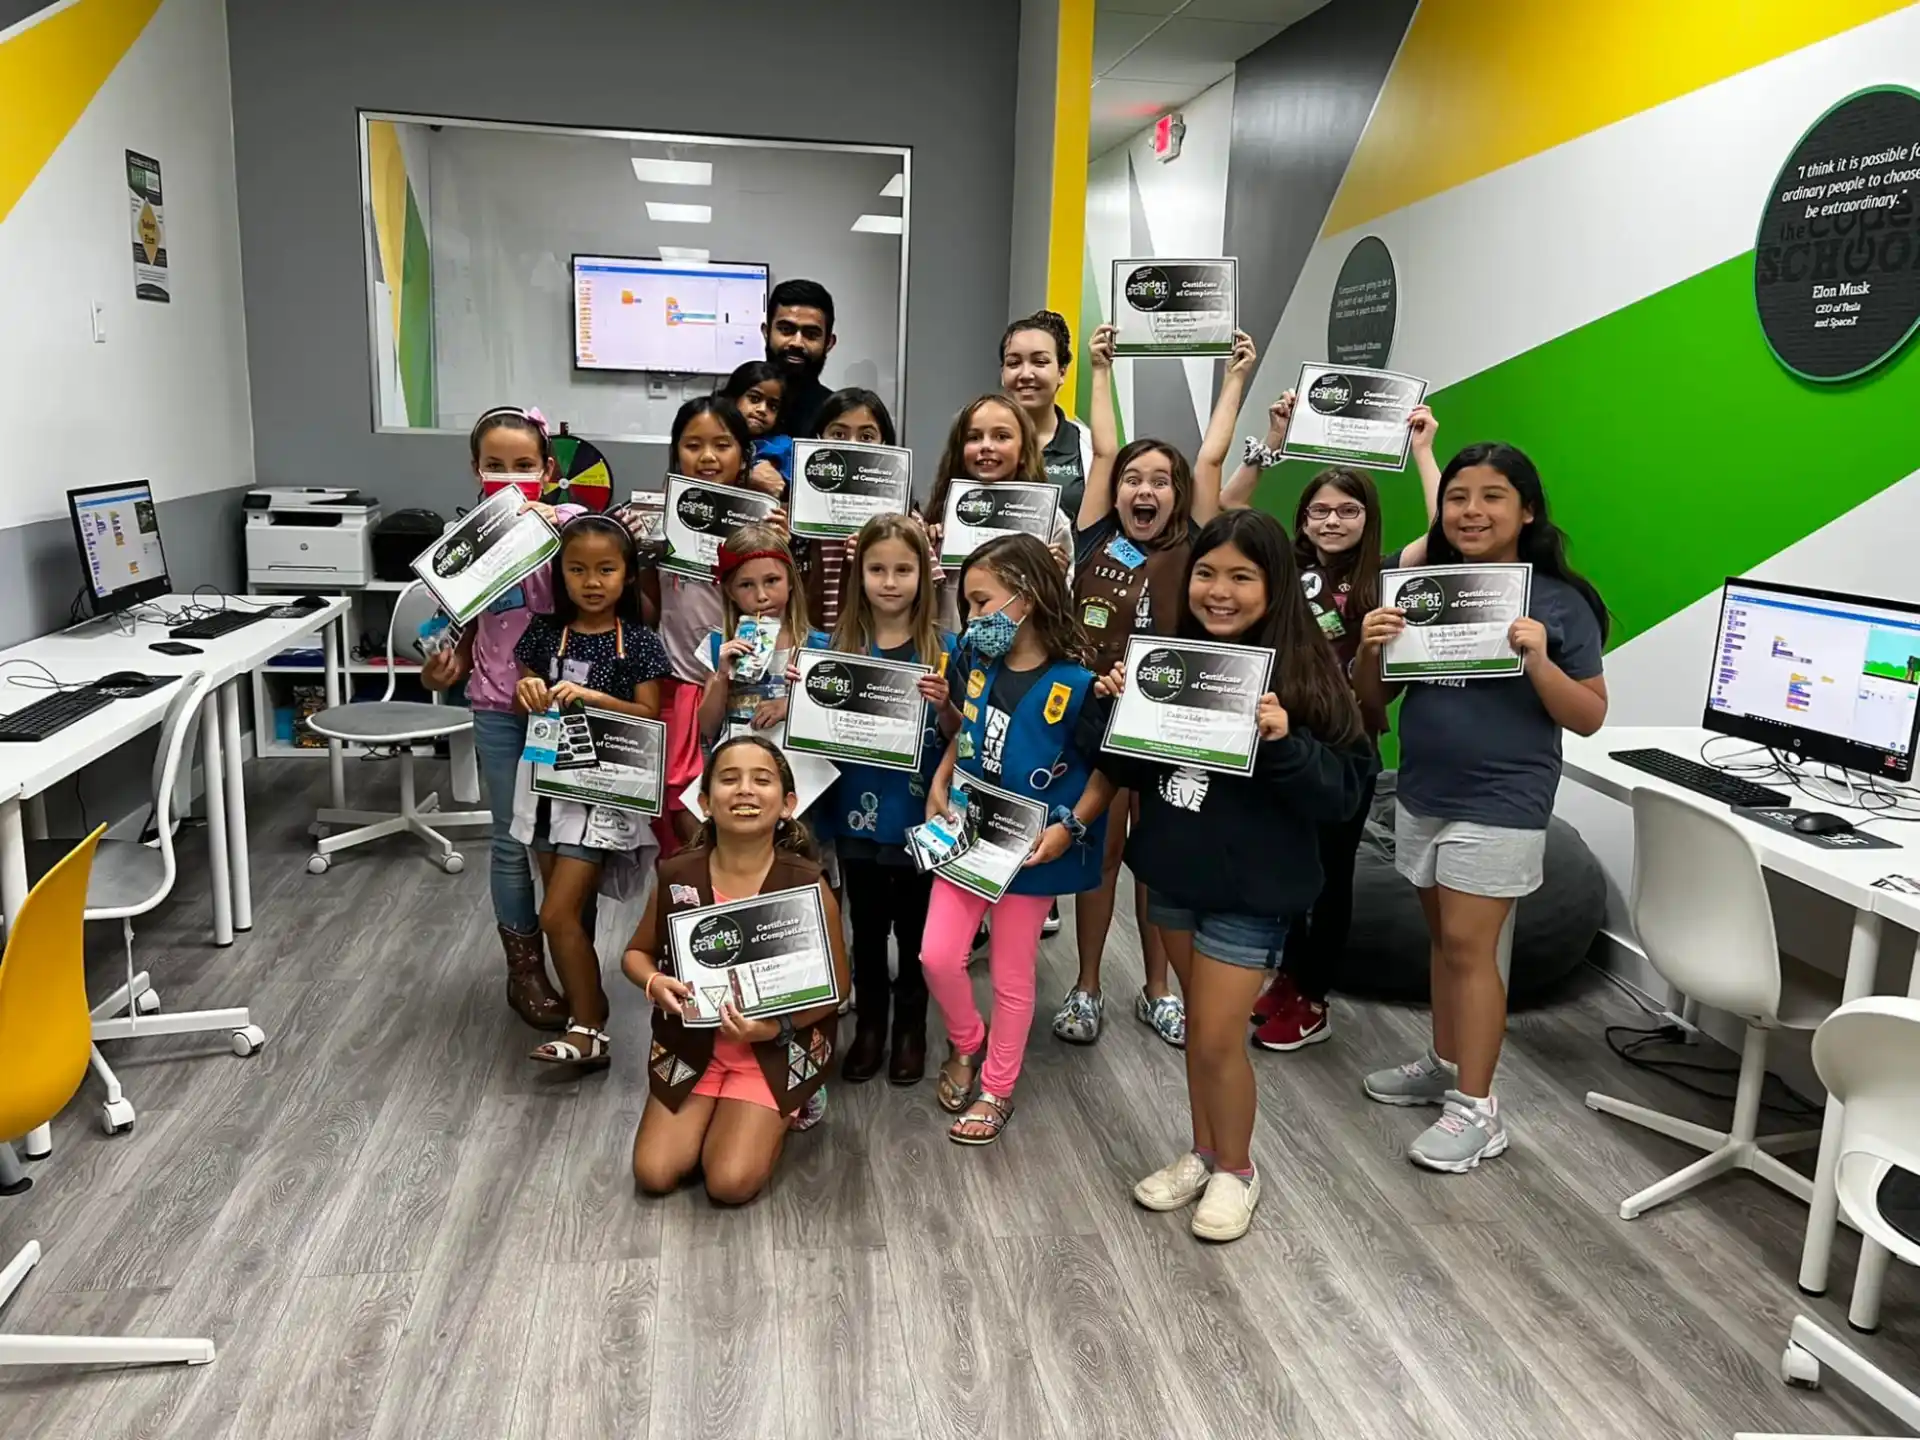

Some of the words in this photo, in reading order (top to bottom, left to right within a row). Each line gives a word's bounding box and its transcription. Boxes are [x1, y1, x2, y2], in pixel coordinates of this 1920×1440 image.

[1807, 159, 1834, 177] think
[1837, 157, 1847, 172] it
[1849, 155, 1859, 169] is
[1860, 146, 1908, 170] possible
[1909, 142, 1920, 162] fo
[1782, 183, 1827, 202] ordinary
[1827, 176, 1865, 197] people
[1868, 172, 1880, 187] to
[1805, 203, 1819, 219] be
[1812, 285, 1837, 299] Elon
[1838, 281, 1871, 297] Musk
[1815, 303, 1833, 314] CEO
[1833, 303, 1841, 313] of
[1814, 318, 1829, 328] and
[1095, 565, 1134, 585] 12021
[1199, 672, 1242, 683] Certificate
[866, 683, 905, 694] Certificate
[982, 757, 1002, 775] 2021
[756, 917, 799, 932] Certificate
